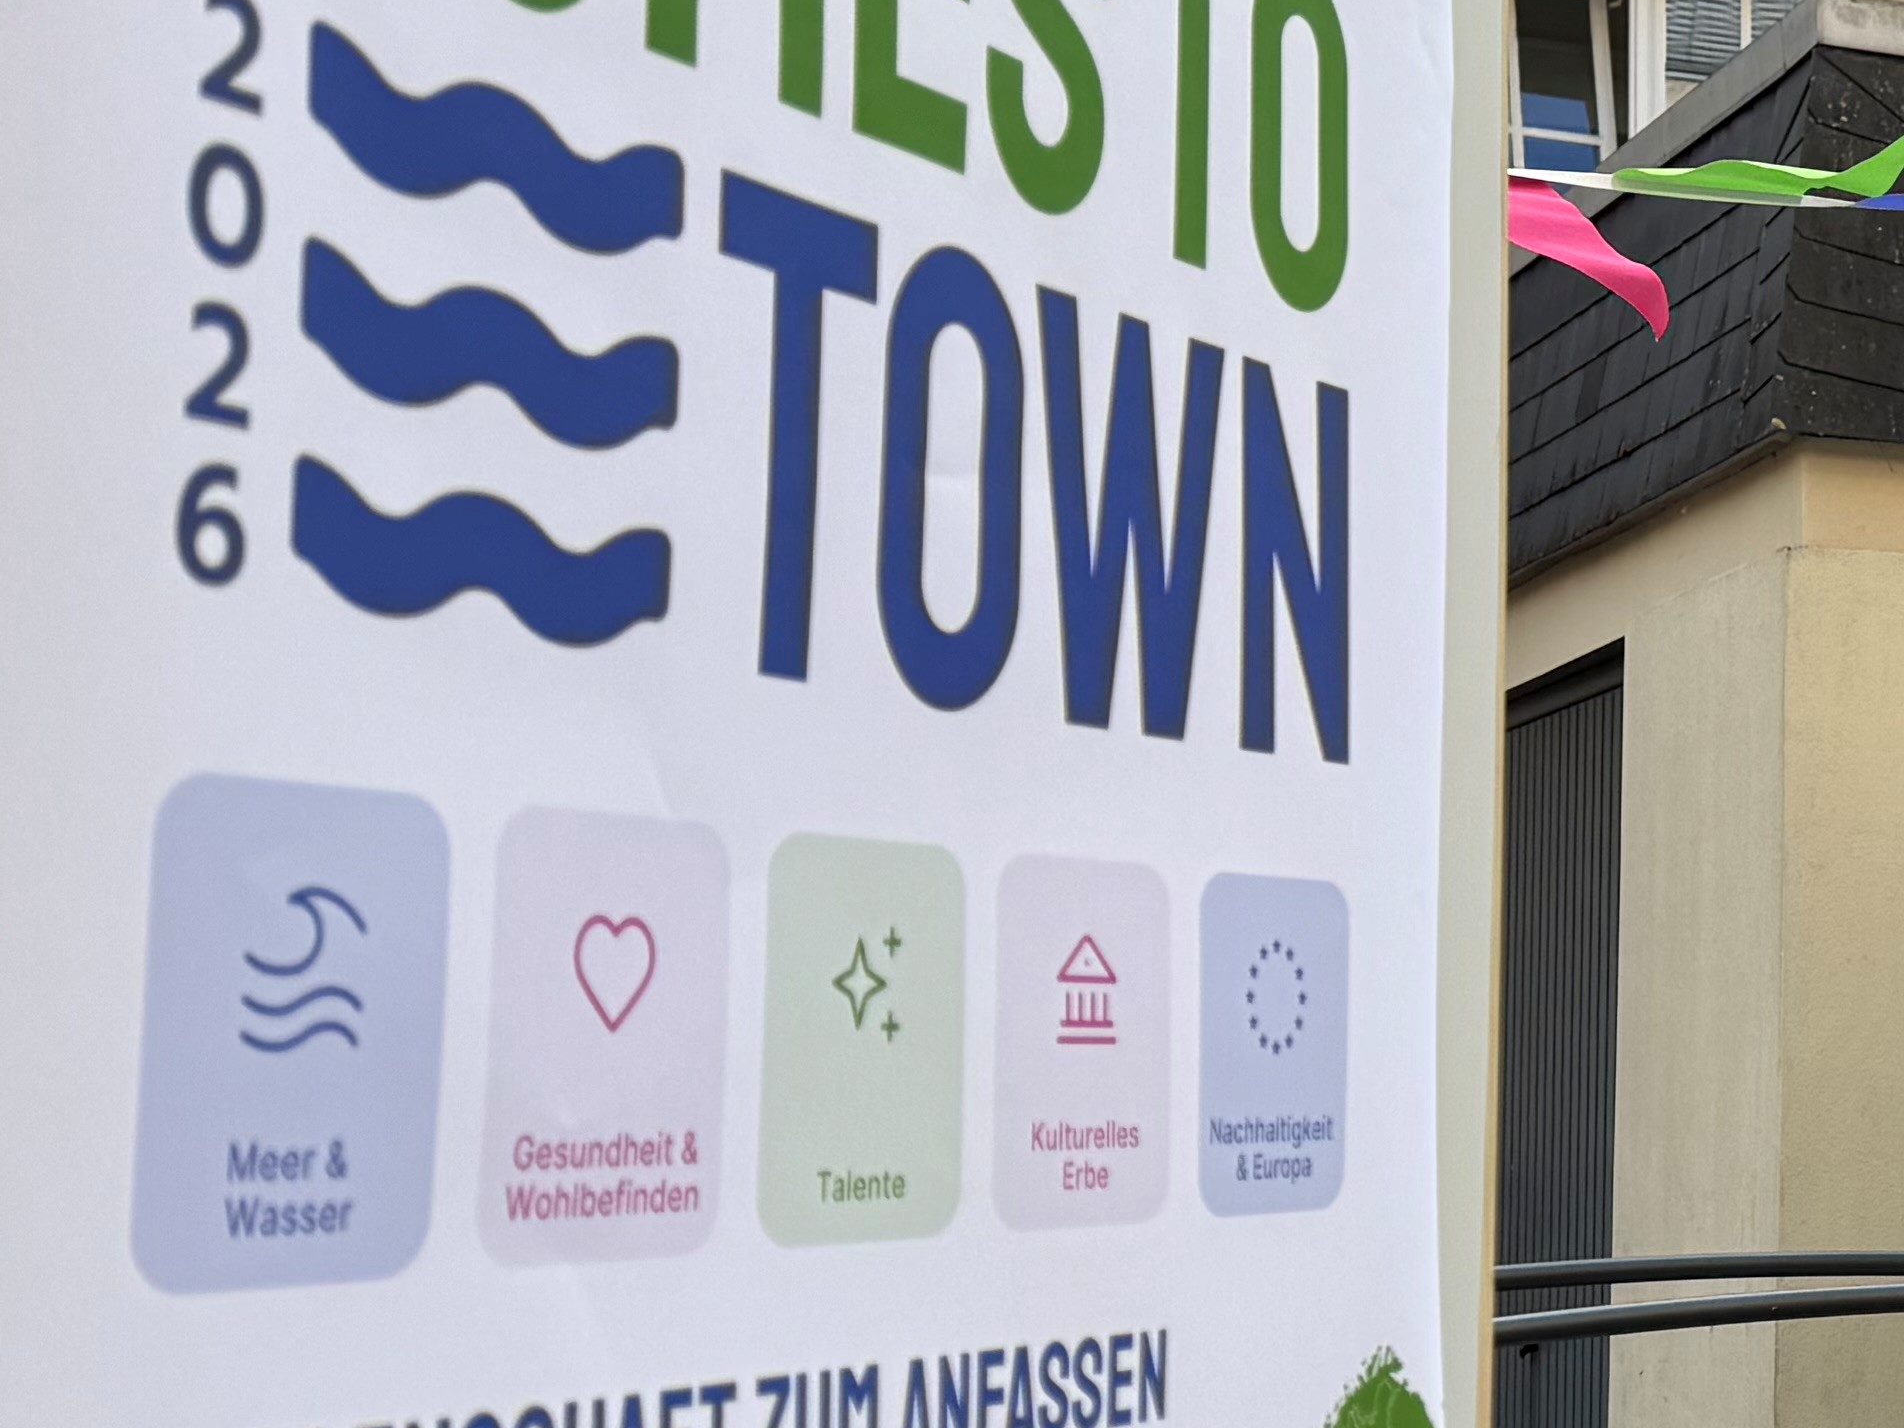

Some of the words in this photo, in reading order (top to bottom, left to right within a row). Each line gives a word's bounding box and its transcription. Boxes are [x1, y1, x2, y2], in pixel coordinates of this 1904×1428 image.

[718, 170, 1349, 763] TOWN
[1031, 1121, 1139, 1151] Kulturelles
[1210, 1115, 1334, 1148] Nachhaltigkeit
[226, 1141, 314, 1183] Meer
[326, 1139, 348, 1180] &
[512, 1132, 674, 1172] Gesundheit
[681, 1130, 698, 1165] &
[1236, 1154, 1247, 1181] &
[1252, 1153, 1312, 1184] Europa
[817, 1170, 906, 1202] Talente
[1062, 1162, 1110, 1190] Erbe
[225, 1196, 353, 1239] Wasser
[506, 1179, 700, 1221] Wohlbefinden
